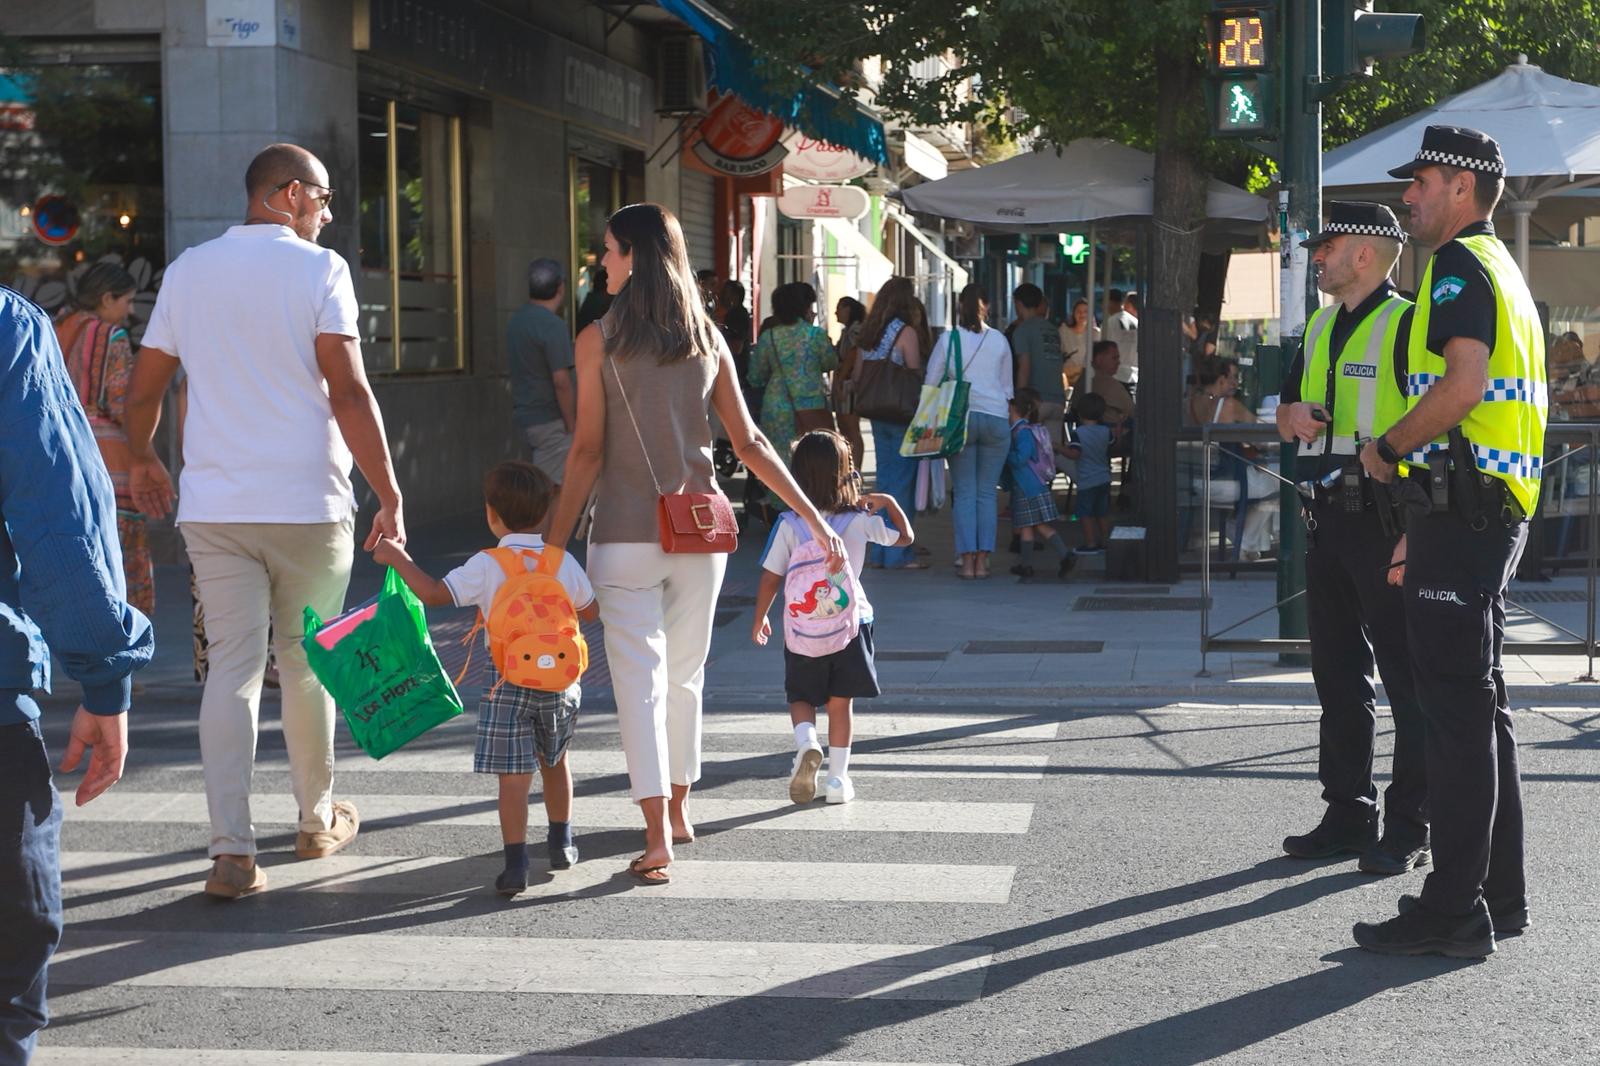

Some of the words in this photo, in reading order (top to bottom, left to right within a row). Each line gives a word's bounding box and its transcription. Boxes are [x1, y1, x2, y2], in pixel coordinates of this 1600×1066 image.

[1220, 18, 1263, 67] 22
[714, 159, 737, 172] BAR
[739, 159, 768, 173] PACO
[1344, 364, 1375, 378] POLICIA
[1419, 587, 1458, 603] POLICIA
